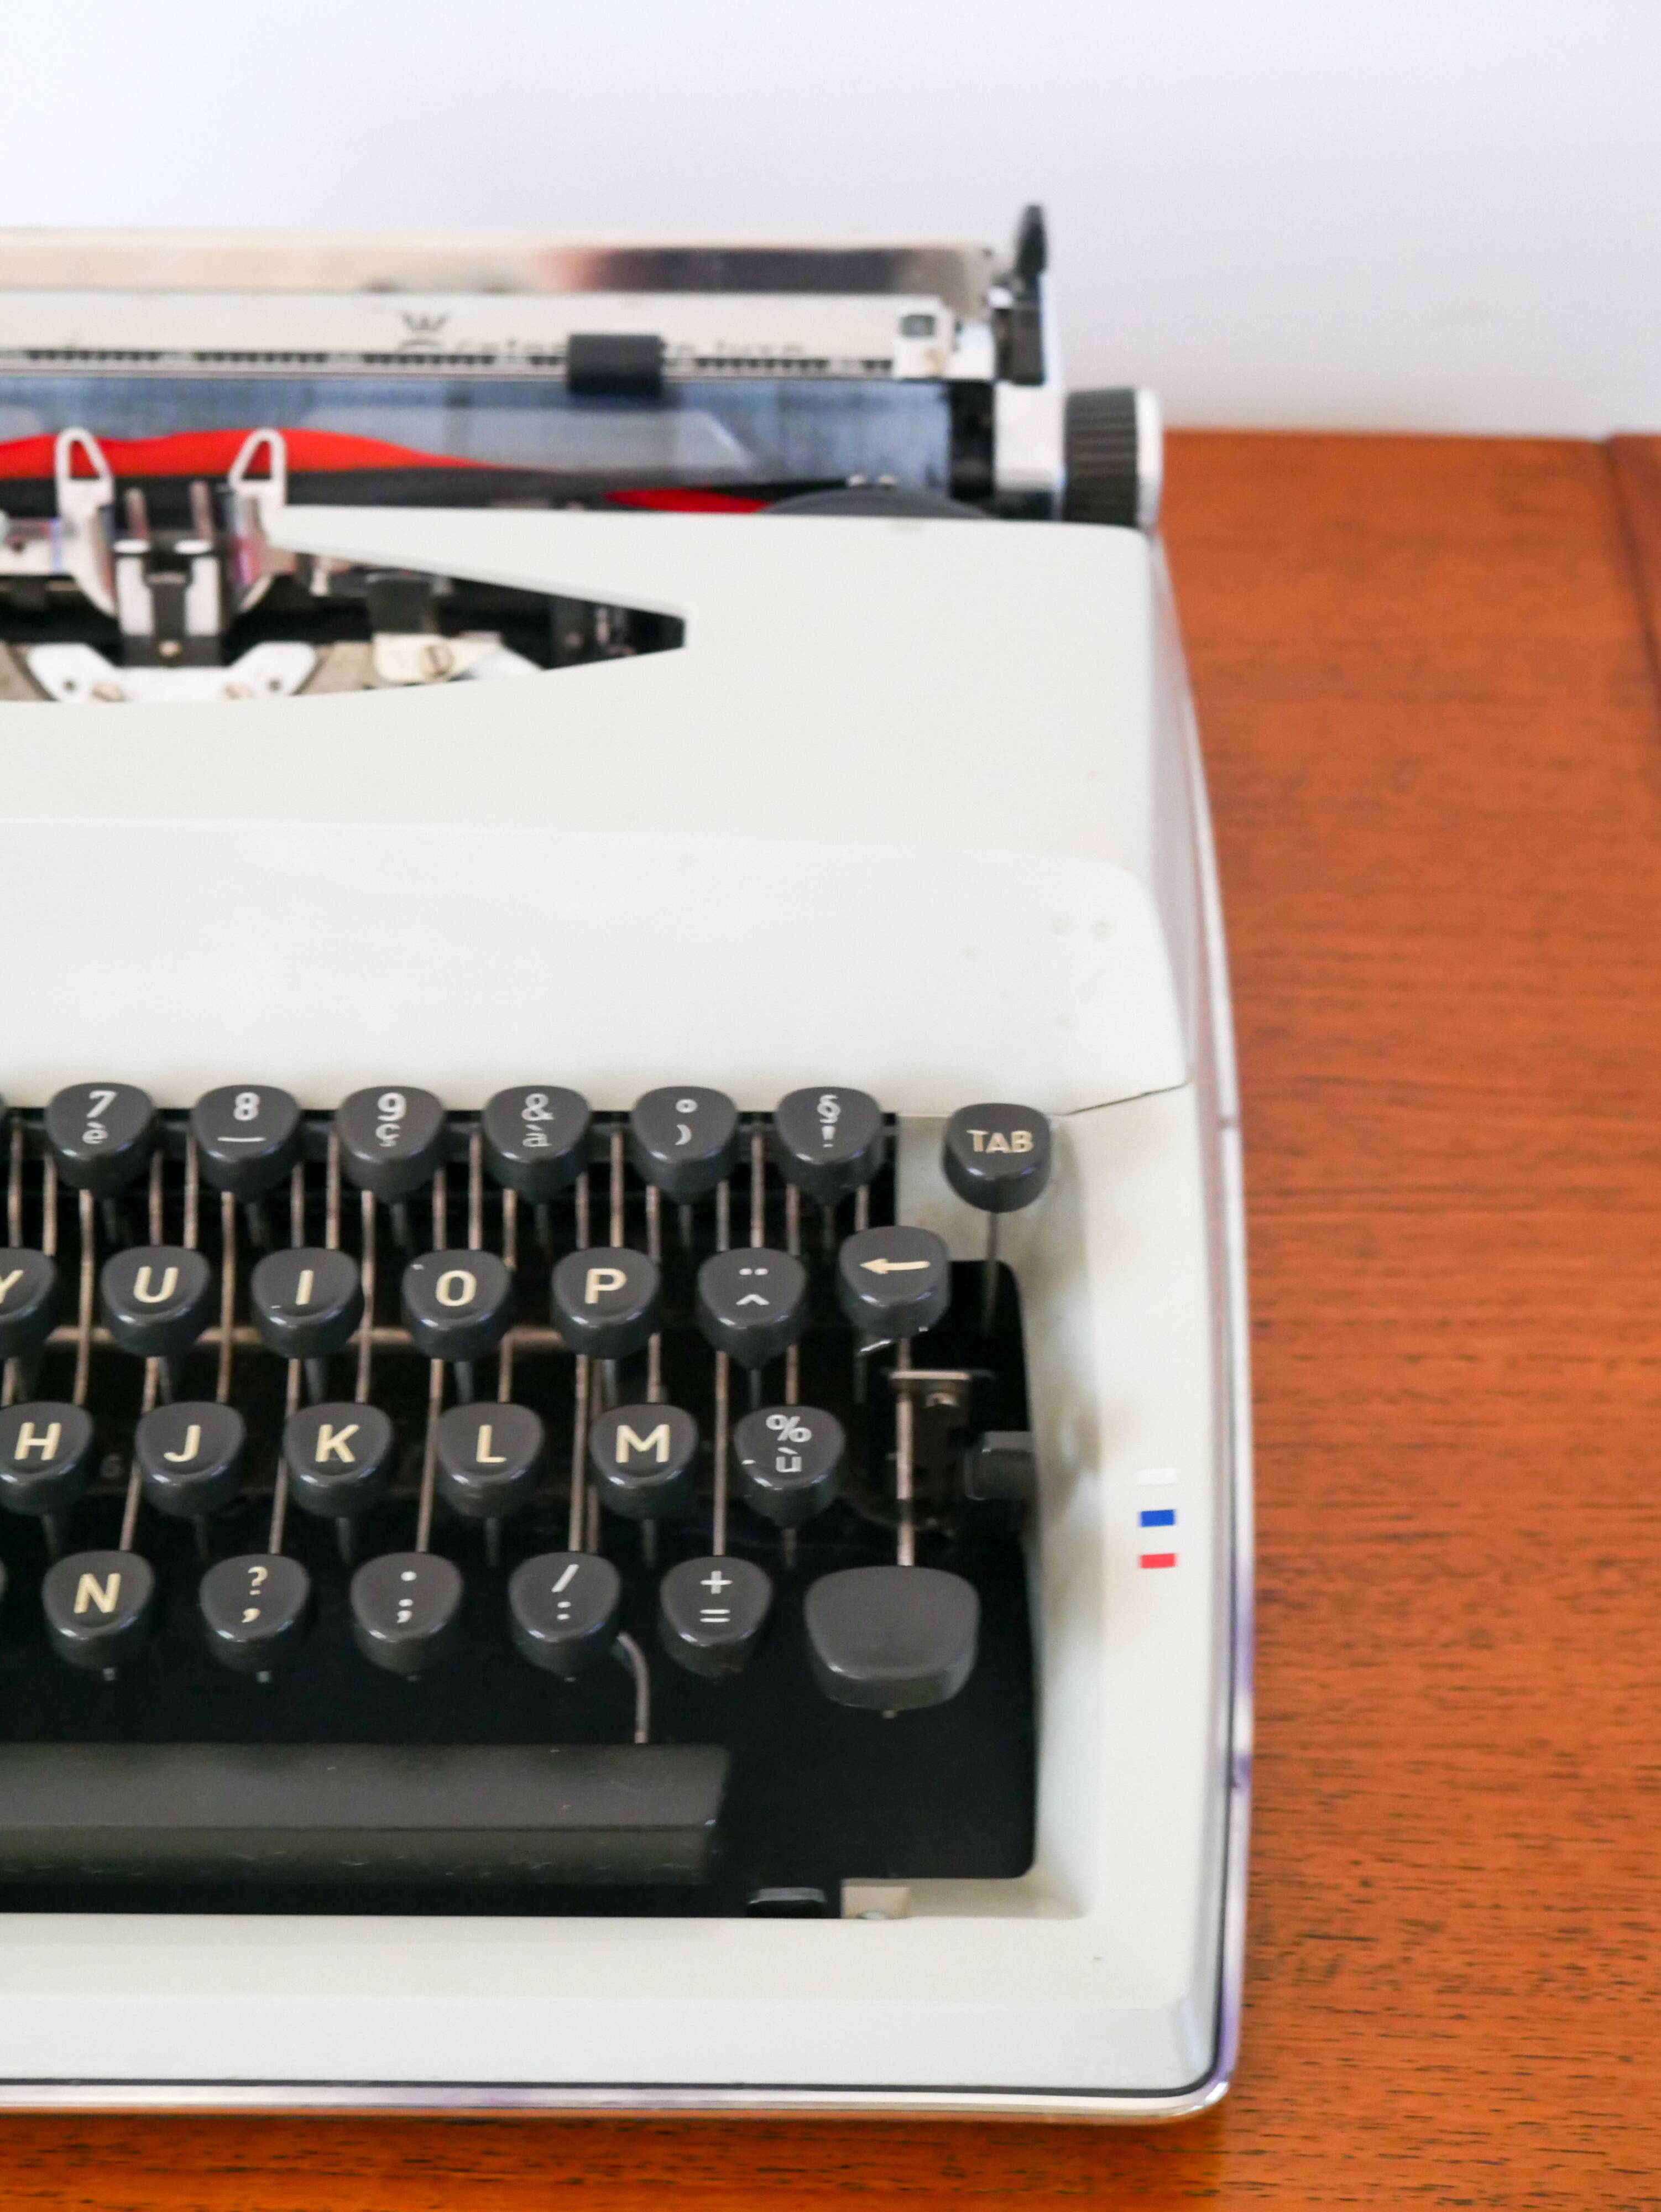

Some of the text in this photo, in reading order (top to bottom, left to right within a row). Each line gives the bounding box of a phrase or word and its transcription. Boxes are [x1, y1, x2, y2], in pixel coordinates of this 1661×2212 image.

[87, 1090, 117, 1118] 7
[234, 1092, 259, 1120] 8
[378, 1092, 405, 1121] 9
[521, 1093, 553, 1121] &
[817, 1094, 840, 1124] §
[82, 1121, 107, 1144] è
[375, 1123, 400, 1147] ç
[523, 1124, 550, 1147] à
[822, 1125, 835, 1147] !
[967, 1129, 1033, 1154] TAB
[134, 1266, 178, 1303] U
[296, 1270, 314, 1306] I
[436, 1270, 477, 1307] O
[585, 1268, 626, 1304] P
[14, 1422, 61, 1460] H
[766, 1414, 812, 1443] %
[164, 1425, 201, 1462] J
[316, 1424, 359, 1463] K
[476, 1425, 506, 1463] L
[616, 1424, 670, 1463] M
[776, 1447, 801, 1473] ù
[74, 1573, 120, 1613] N
[248, 1566, 268, 1595] ?
[551, 1564, 579, 1593] /
[701, 1571, 732, 1594] +
[397, 1599, 413, 1623] ;
[700, 1609, 730, 1623] =
